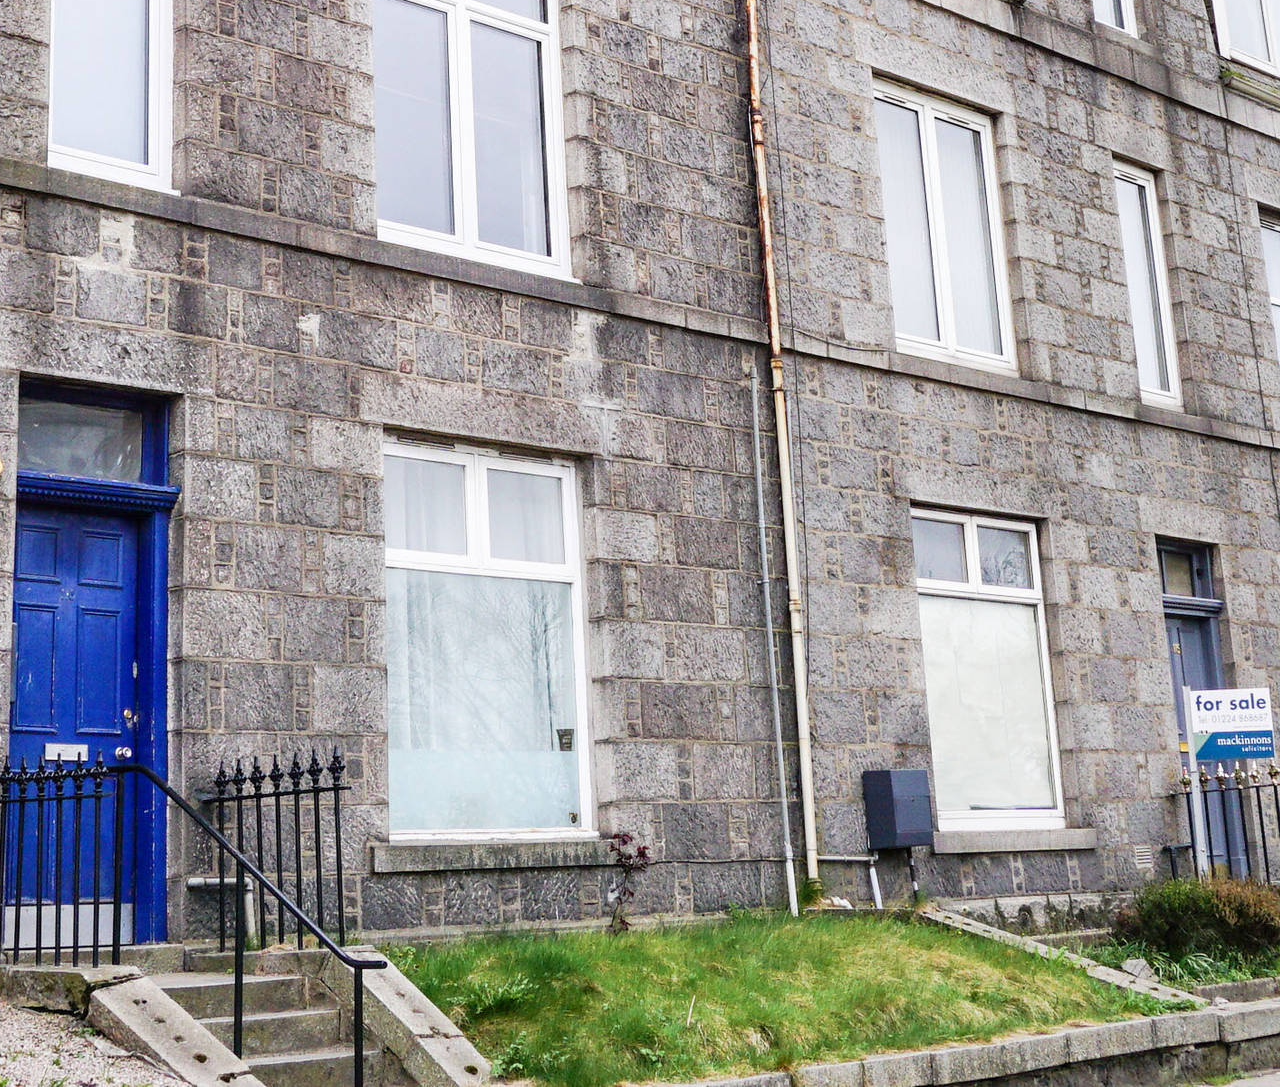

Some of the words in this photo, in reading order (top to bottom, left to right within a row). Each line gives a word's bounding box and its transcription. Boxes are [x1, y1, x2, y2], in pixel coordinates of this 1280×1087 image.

[1196, 695, 1222, 711] for
[1230, 693, 1266, 710] sale
[1217, 734, 1272, 745] mackinnons
